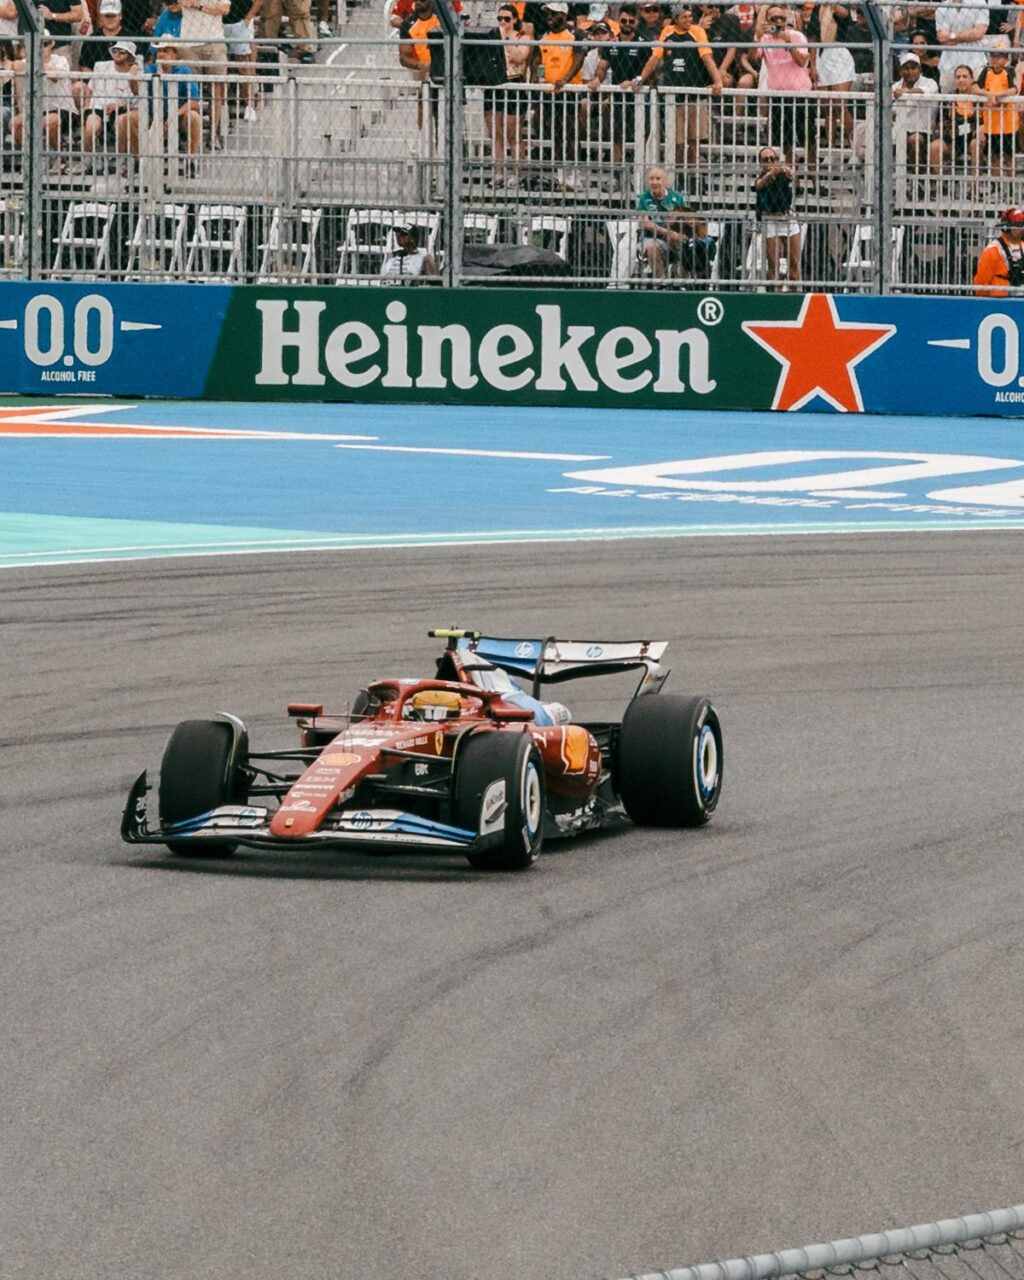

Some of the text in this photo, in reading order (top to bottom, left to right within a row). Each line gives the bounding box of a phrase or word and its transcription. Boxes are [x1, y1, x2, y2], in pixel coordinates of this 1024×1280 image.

[24, 293, 114, 367] 0.0
[255, 299, 717, 394] Heineken
[41, 370, 96, 382] ALCOHOL FREE
[350, 811, 374, 830] hp
